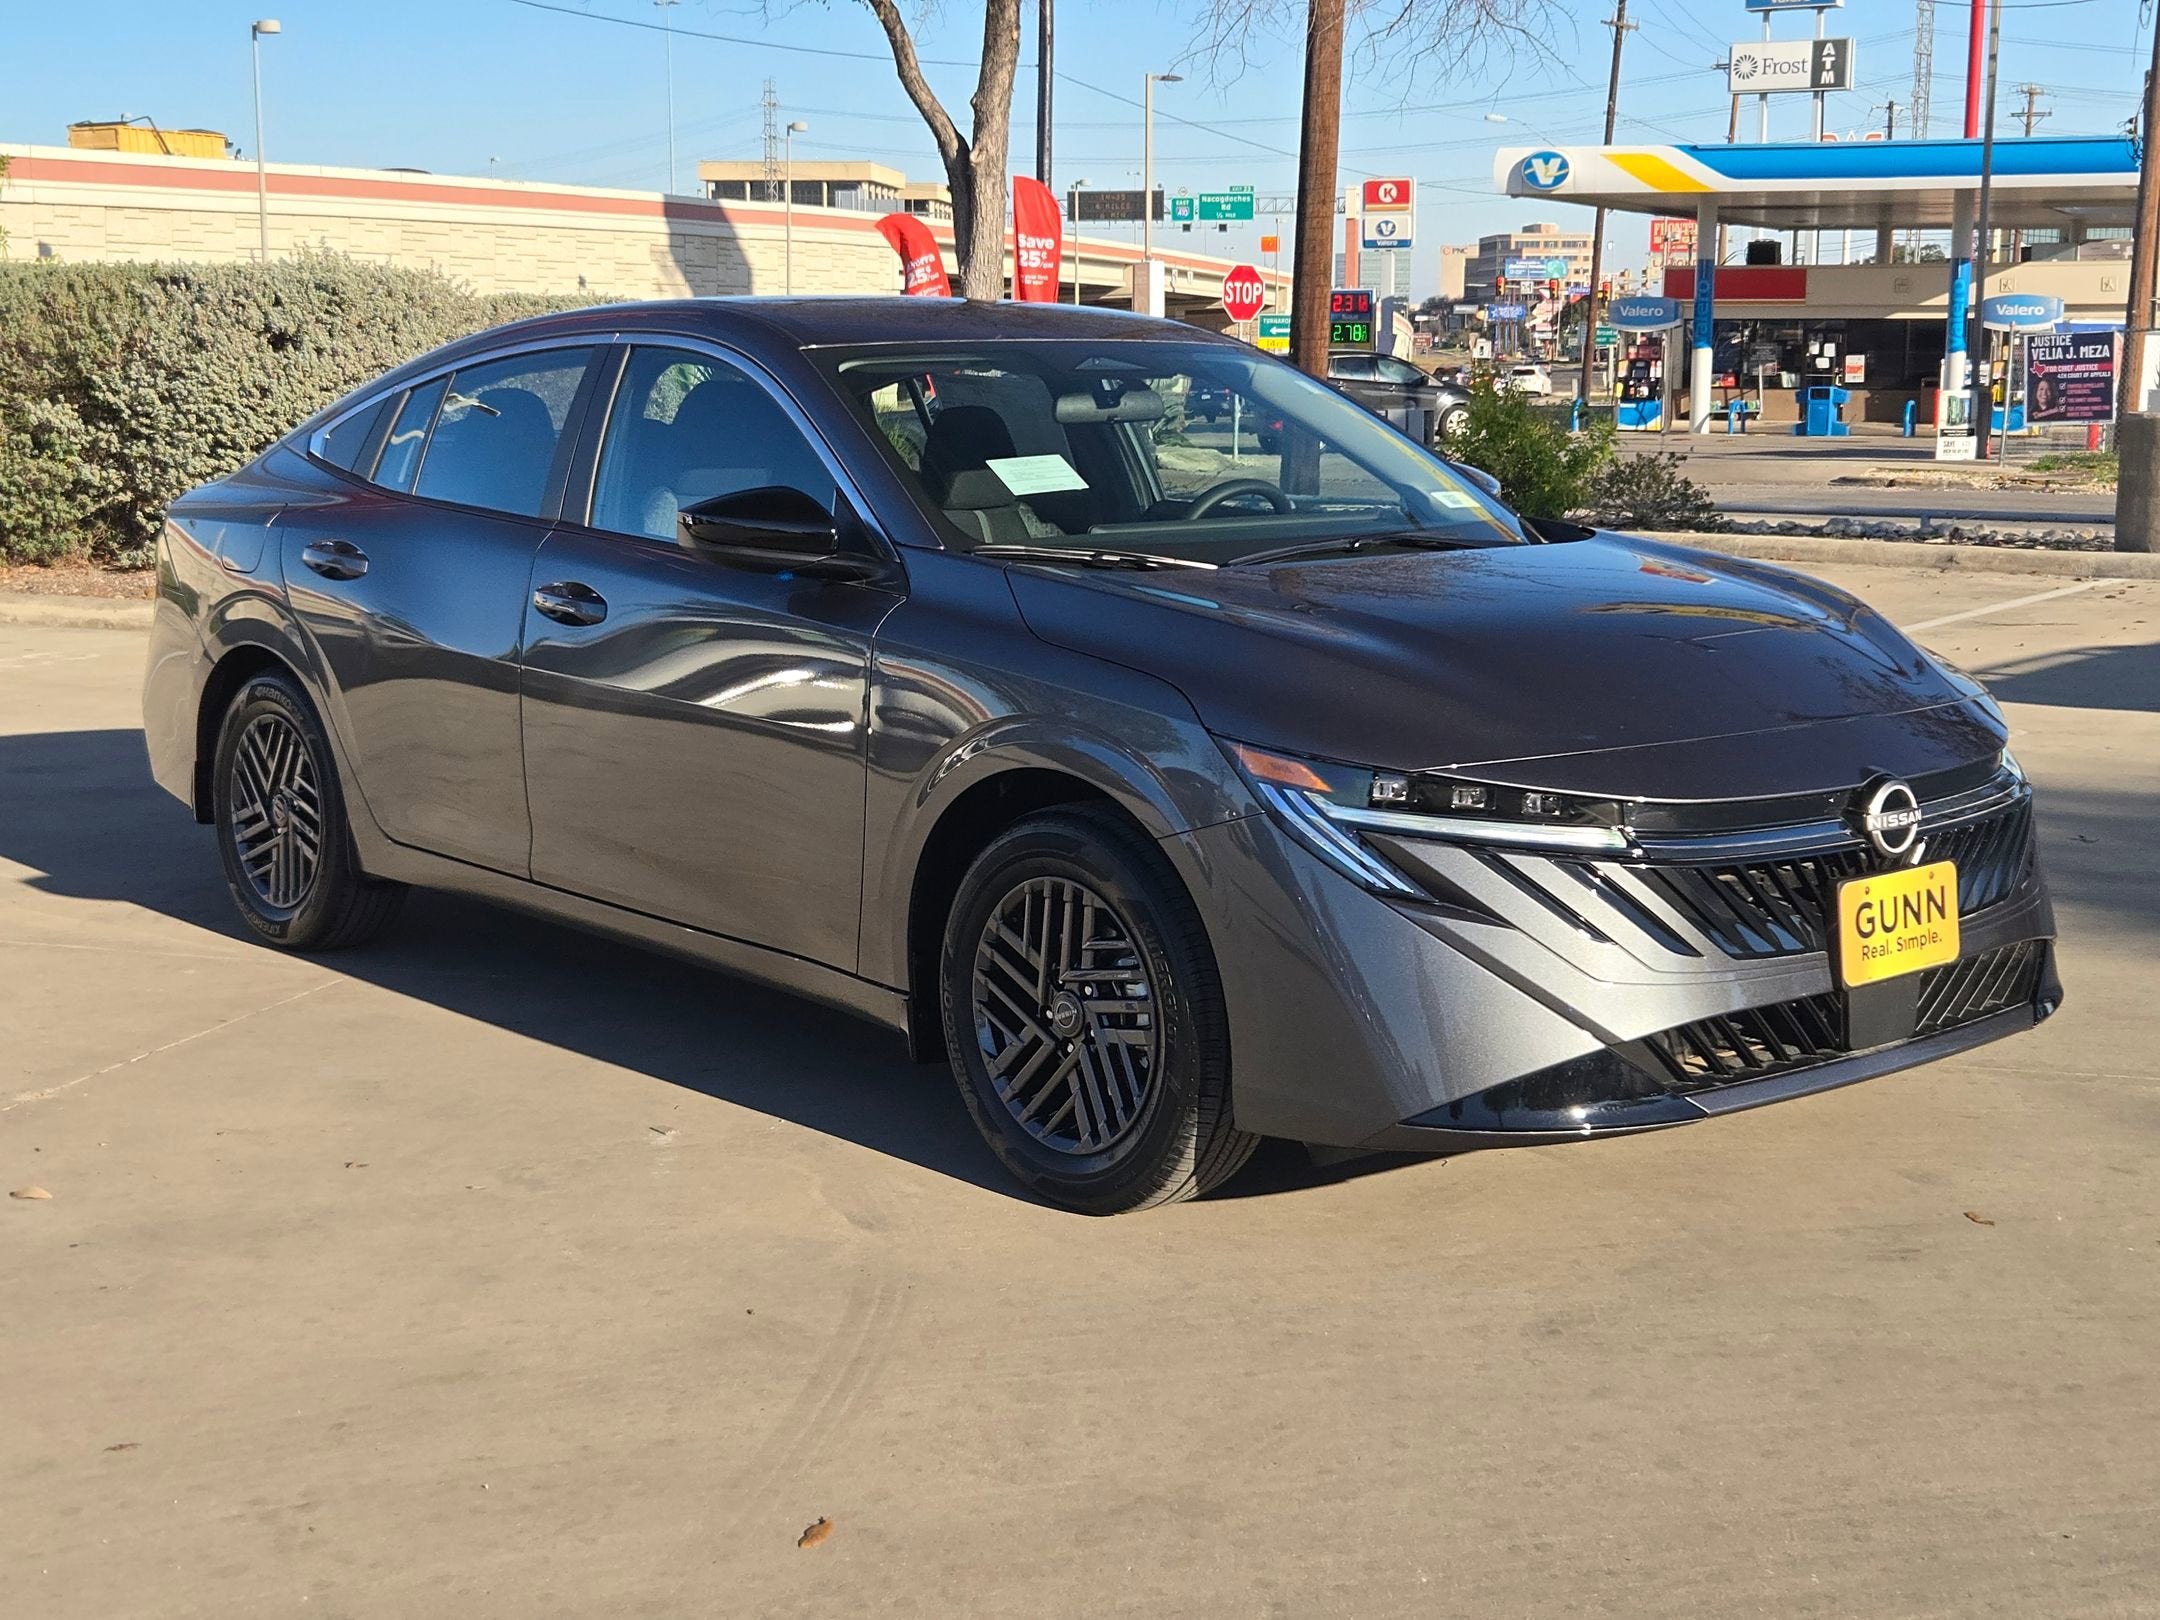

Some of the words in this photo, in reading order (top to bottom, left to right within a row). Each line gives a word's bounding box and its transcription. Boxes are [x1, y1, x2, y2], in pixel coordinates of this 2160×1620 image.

[1761, 57, 1808, 75] Frost
[1820, 42, 1836, 84] ATM
[1201, 195, 1251, 204] Nacogdoches
[1221, 203, 1232, 211] Rd
[1017, 234, 1055, 249] Save
[1224, 281, 1263, 304] STOP
[1619, 305, 1664, 317] Valero
[1996, 304, 2045, 316] Valero
[2031, 335, 2072, 347] JUSTICE
[2031, 347, 2063, 360] VELIA
[2066, 346, 2077, 359] J.
[2080, 344, 2110, 358] MEZA
[2074, 363, 2098, 372] JUSTICE
[1867, 807, 1922, 831] NISSAN
[1855, 885, 1946, 939] GUNN
[1861, 940, 1893, 962] Real.
[1896, 928, 1943, 953] Simple.
